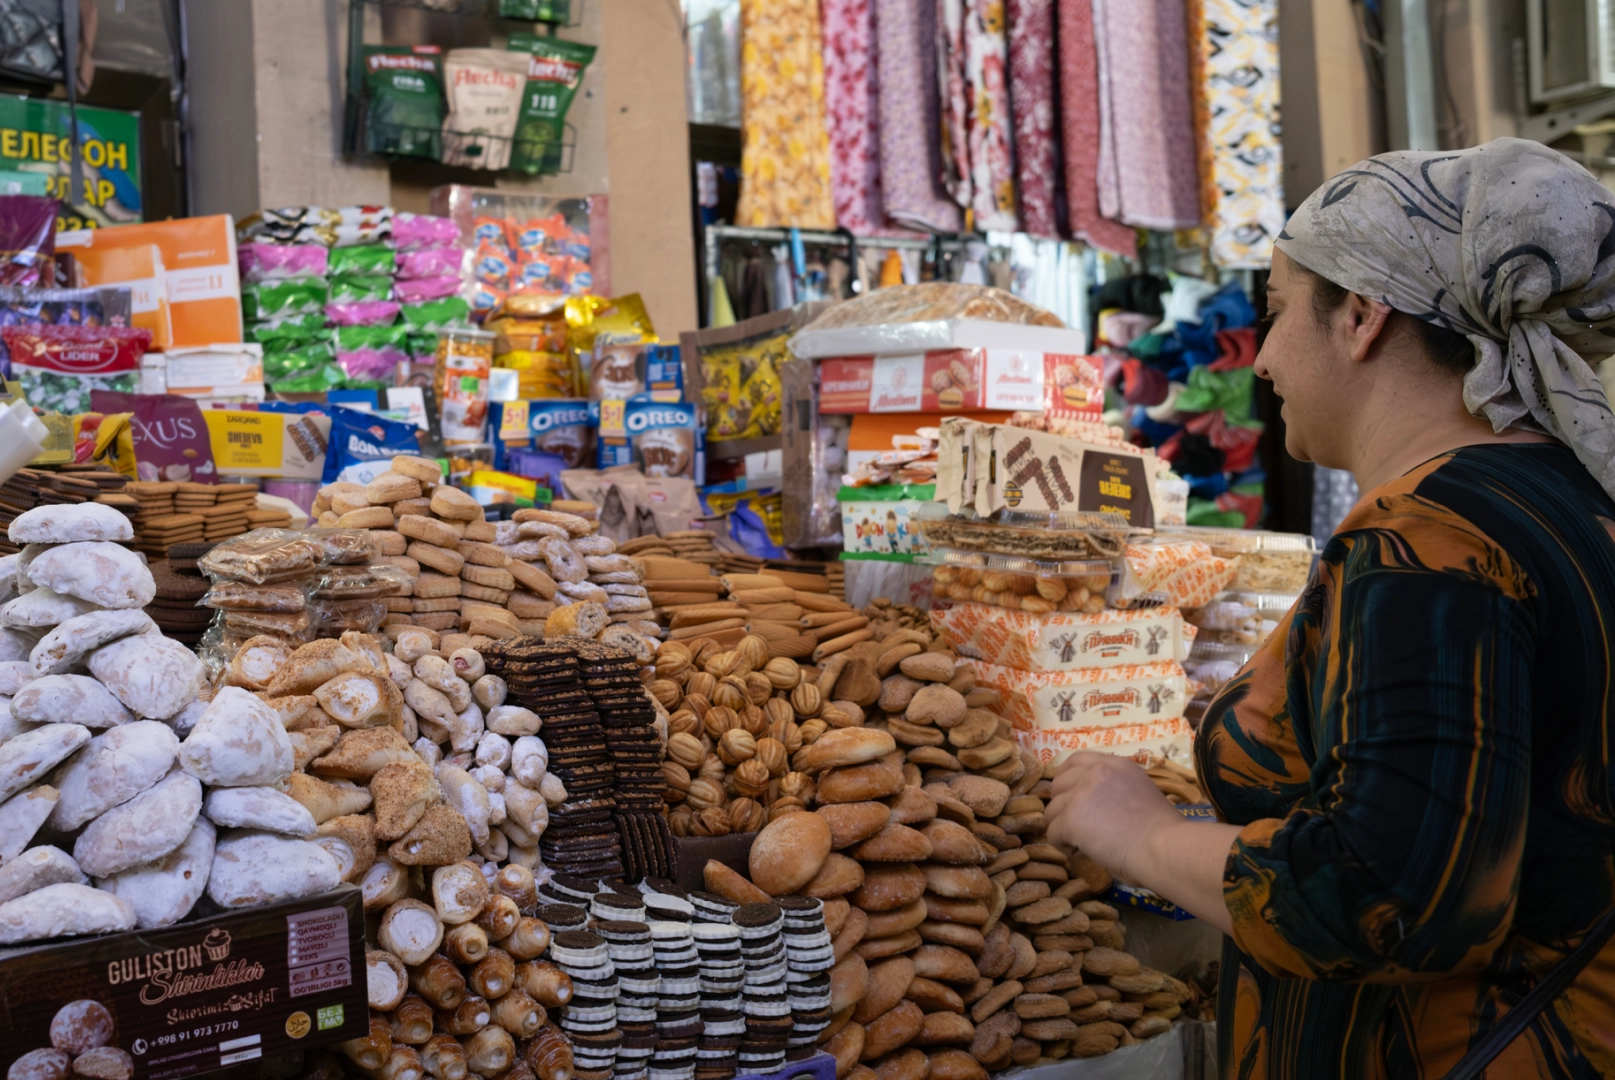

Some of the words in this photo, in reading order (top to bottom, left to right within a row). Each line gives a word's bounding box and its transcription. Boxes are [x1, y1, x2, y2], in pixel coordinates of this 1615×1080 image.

[60, 351, 101, 362] LIDER
[628, 411, 688, 430] OREO
[297, 913, 345, 927] SHOKOLADLI
[297, 922, 337, 936] QAYMOQLI
[298, 932, 335, 945] TVOROGLI
[299, 942, 328, 953] MAYIZLI
[108, 944, 203, 985] GULISTON
[299, 953, 319, 962] KEKS
[139, 958, 266, 1005] Shirinliklar
[333, 979, 348, 987] 3kg
[318, 1005, 343, 1019] БЕЗ
[150, 1034, 177, 1048] +998
[178, 1030, 191, 1042] 91
[194, 1026, 213, 1038] 973
[214, 1020, 239, 1033] 7770
